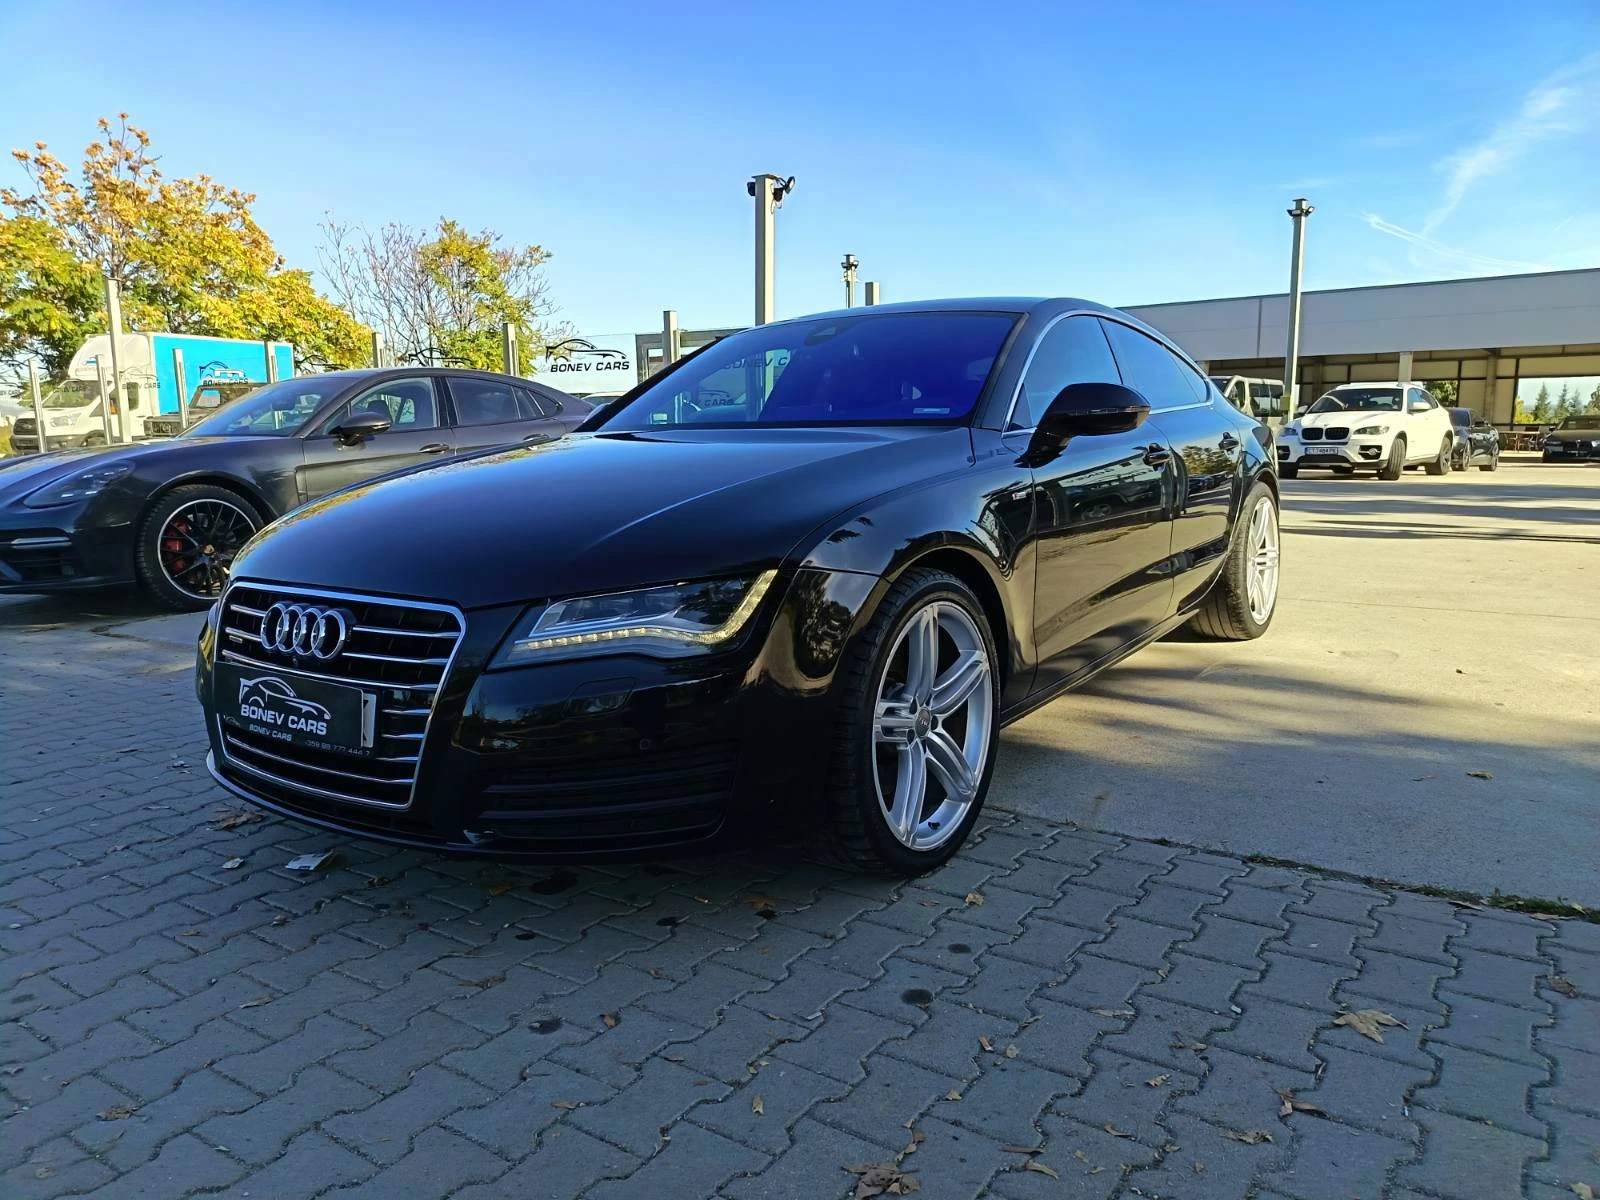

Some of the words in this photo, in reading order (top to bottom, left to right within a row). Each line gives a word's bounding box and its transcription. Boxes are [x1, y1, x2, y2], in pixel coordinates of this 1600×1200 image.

[550, 362, 592, 373] BONEV
[596, 360, 630, 371] CARS
[240, 703, 285, 726] BONEV
[287, 715, 328, 736] CARS
[249, 723, 270, 736] BONEV
[271, 730, 292, 742] CARS
